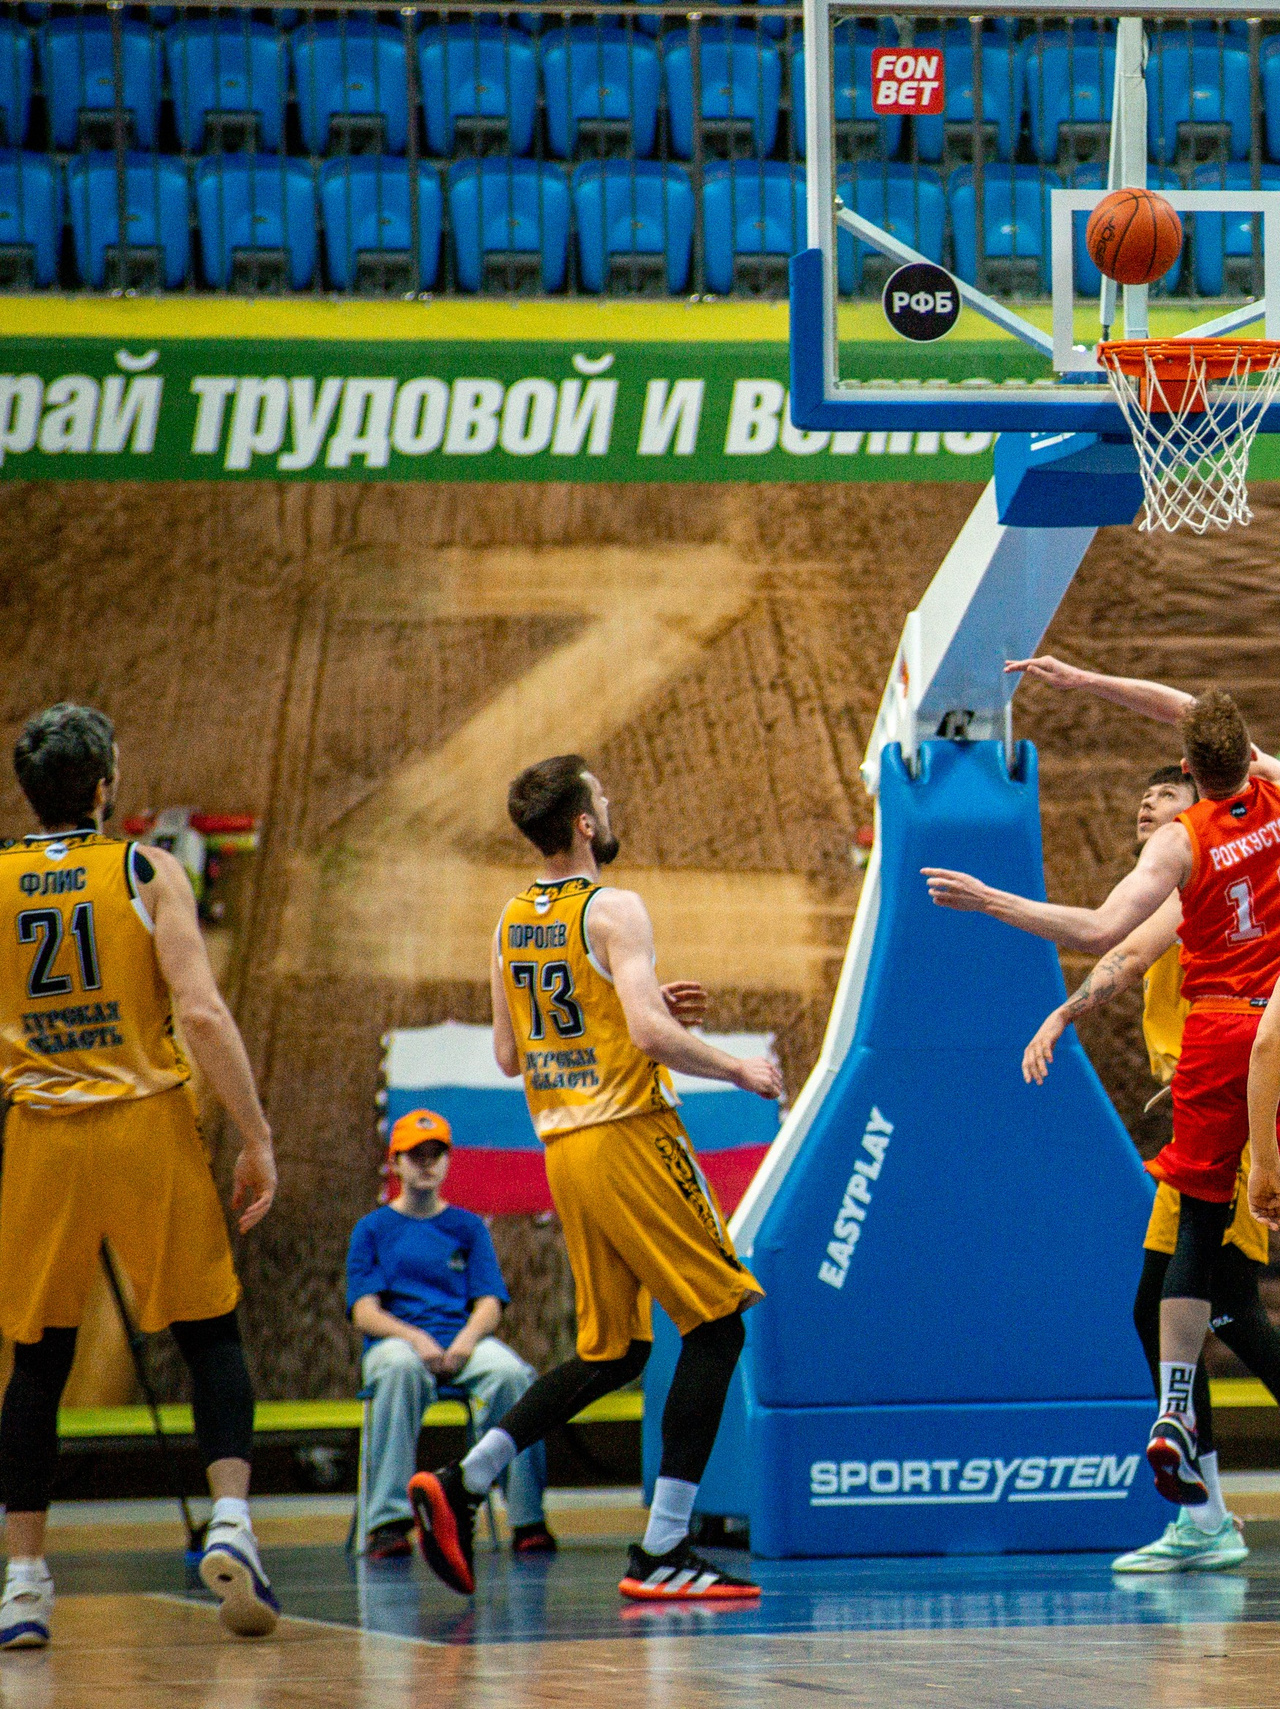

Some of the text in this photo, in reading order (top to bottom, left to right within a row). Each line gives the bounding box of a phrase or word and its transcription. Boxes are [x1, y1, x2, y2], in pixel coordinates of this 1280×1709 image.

[876, 55, 939, 79] FON
[876, 80, 939, 106] BET
[892, 291, 953, 313] РФБ
[191, 353, 618, 471] трудовой
[637, 378, 705, 456] и
[20, 867, 87, 896] ФЛИС
[16, 901, 102, 999] 21
[509, 960, 585, 1040] 73
[817, 1104, 895, 1290] EASYPLAY
